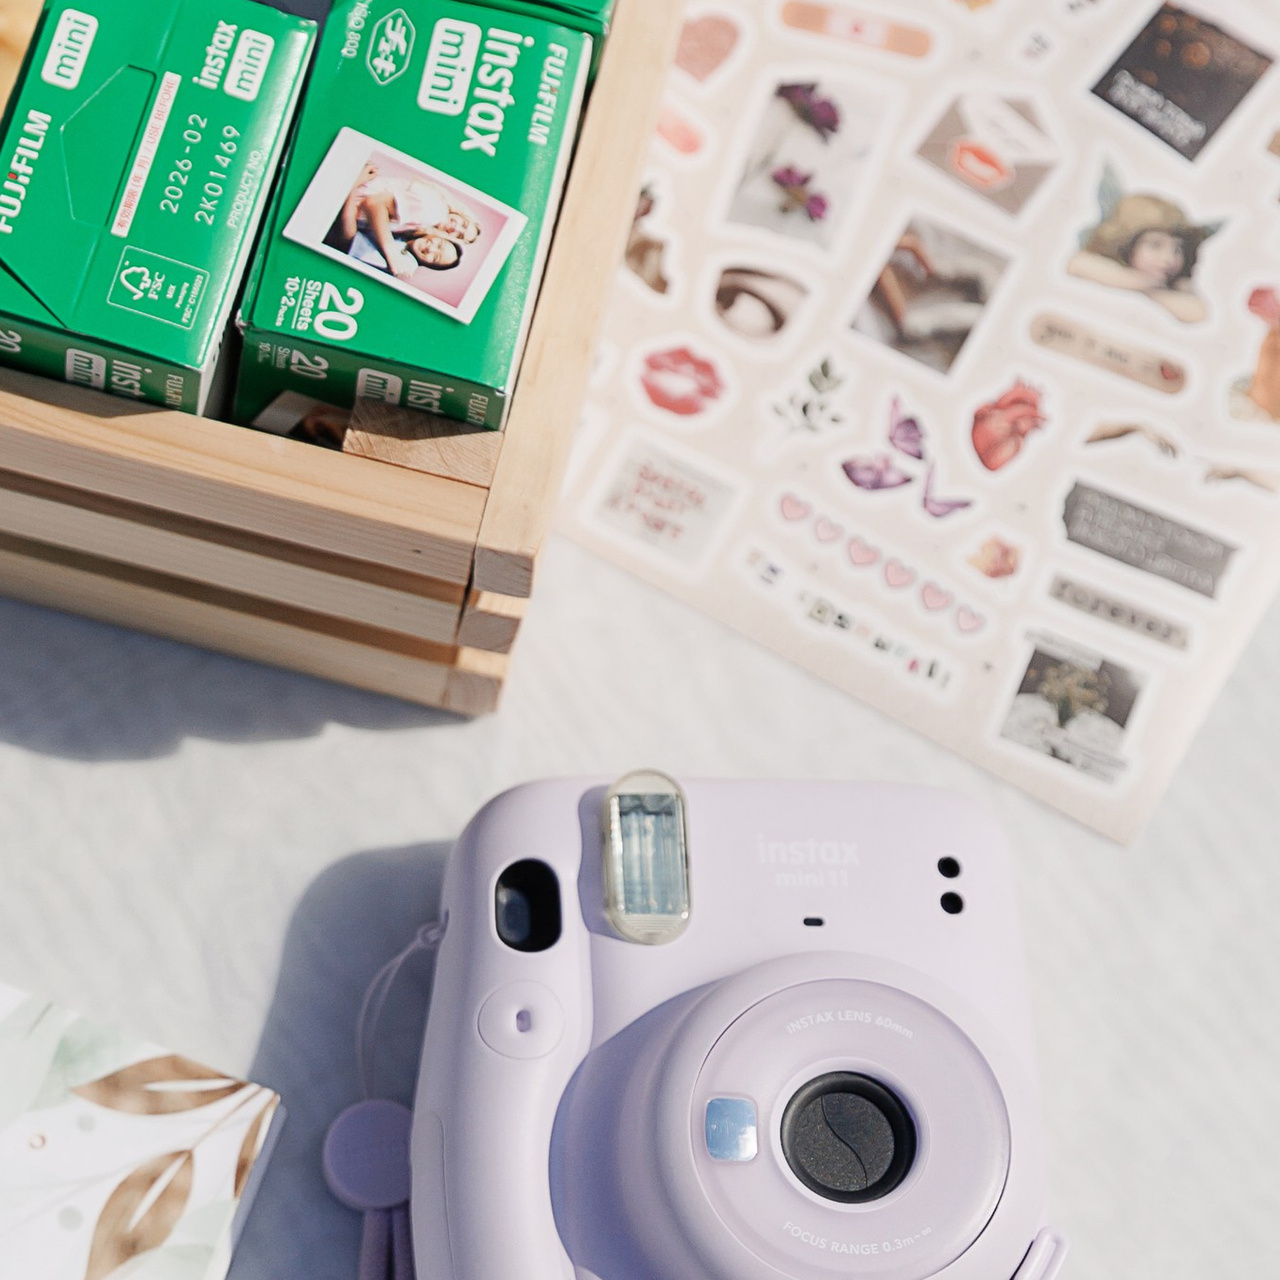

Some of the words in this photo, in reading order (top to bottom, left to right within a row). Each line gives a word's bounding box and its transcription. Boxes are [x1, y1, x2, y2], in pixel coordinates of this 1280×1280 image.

[54, 15, 91, 82] mini
[192, 20, 238, 90] instax
[236, 36, 270, 93] mini
[428, 28, 459, 107] mini
[148, 119, 163, 145] USE
[156, 78, 178, 119] BEFORE
[460, 27, 535, 157] instax
[527, 43, 569, 146] FUJIFILM
[160, 113, 208, 214] 2026-02
[194, 125, 242, 226] 2K01469
[227, 170, 256, 229] PRODUCT
[147, 273, 166, 302] FSC
[296, 280, 322, 331] Sheets
[312, 286, 365, 341] 20
[290, 350, 330, 380] 20
[756, 831, 861, 866] instax
[775, 868, 825, 887] mini
[786, 1011, 835, 1034] INSTAX
[838, 1010, 872, 1024] LENS
[875, 1015, 914, 1039] 60mm
[783, 1220, 828, 1249] FOCUS
[830, 1241, 880, 1255] RANGE
